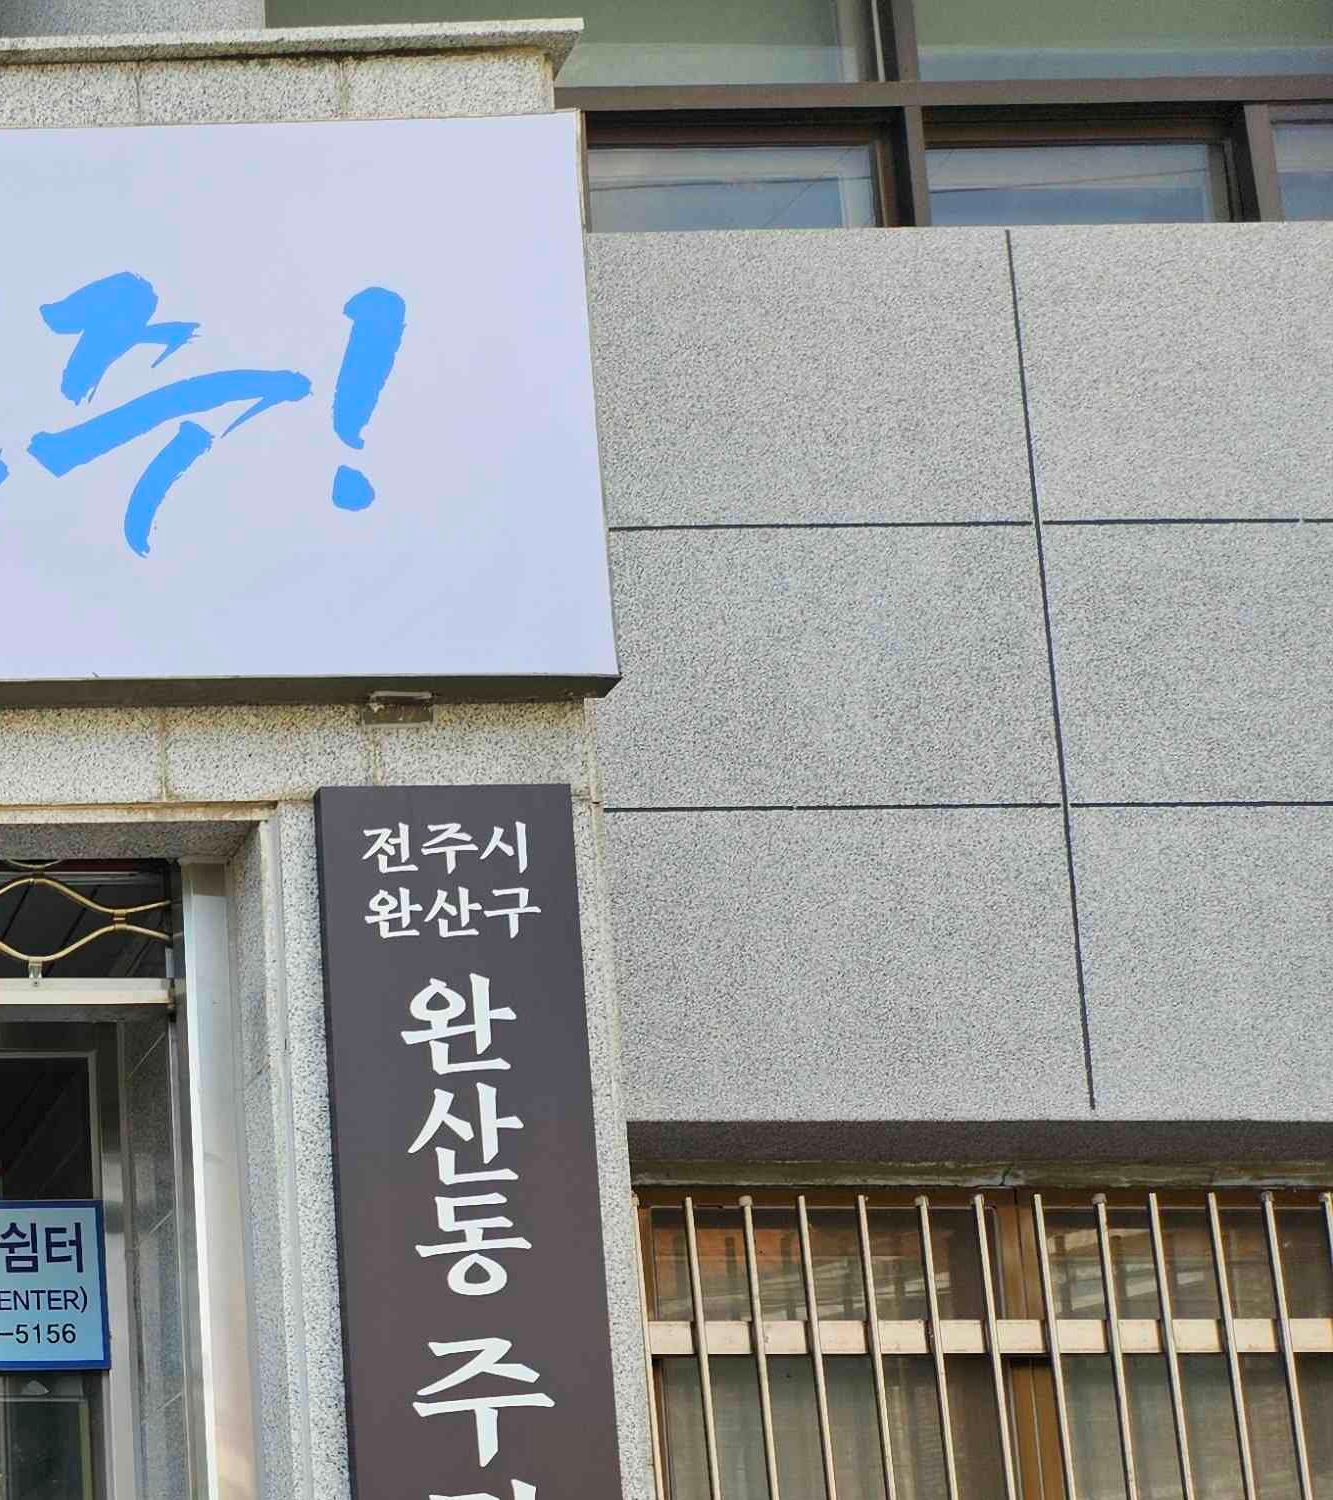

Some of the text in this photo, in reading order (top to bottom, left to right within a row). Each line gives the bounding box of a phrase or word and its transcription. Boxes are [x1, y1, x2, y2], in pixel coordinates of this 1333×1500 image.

[362, 821, 529, 875] 전주시
[364, 887, 541, 940] 완산구
[401, 972, 532, 1296] 완산동
